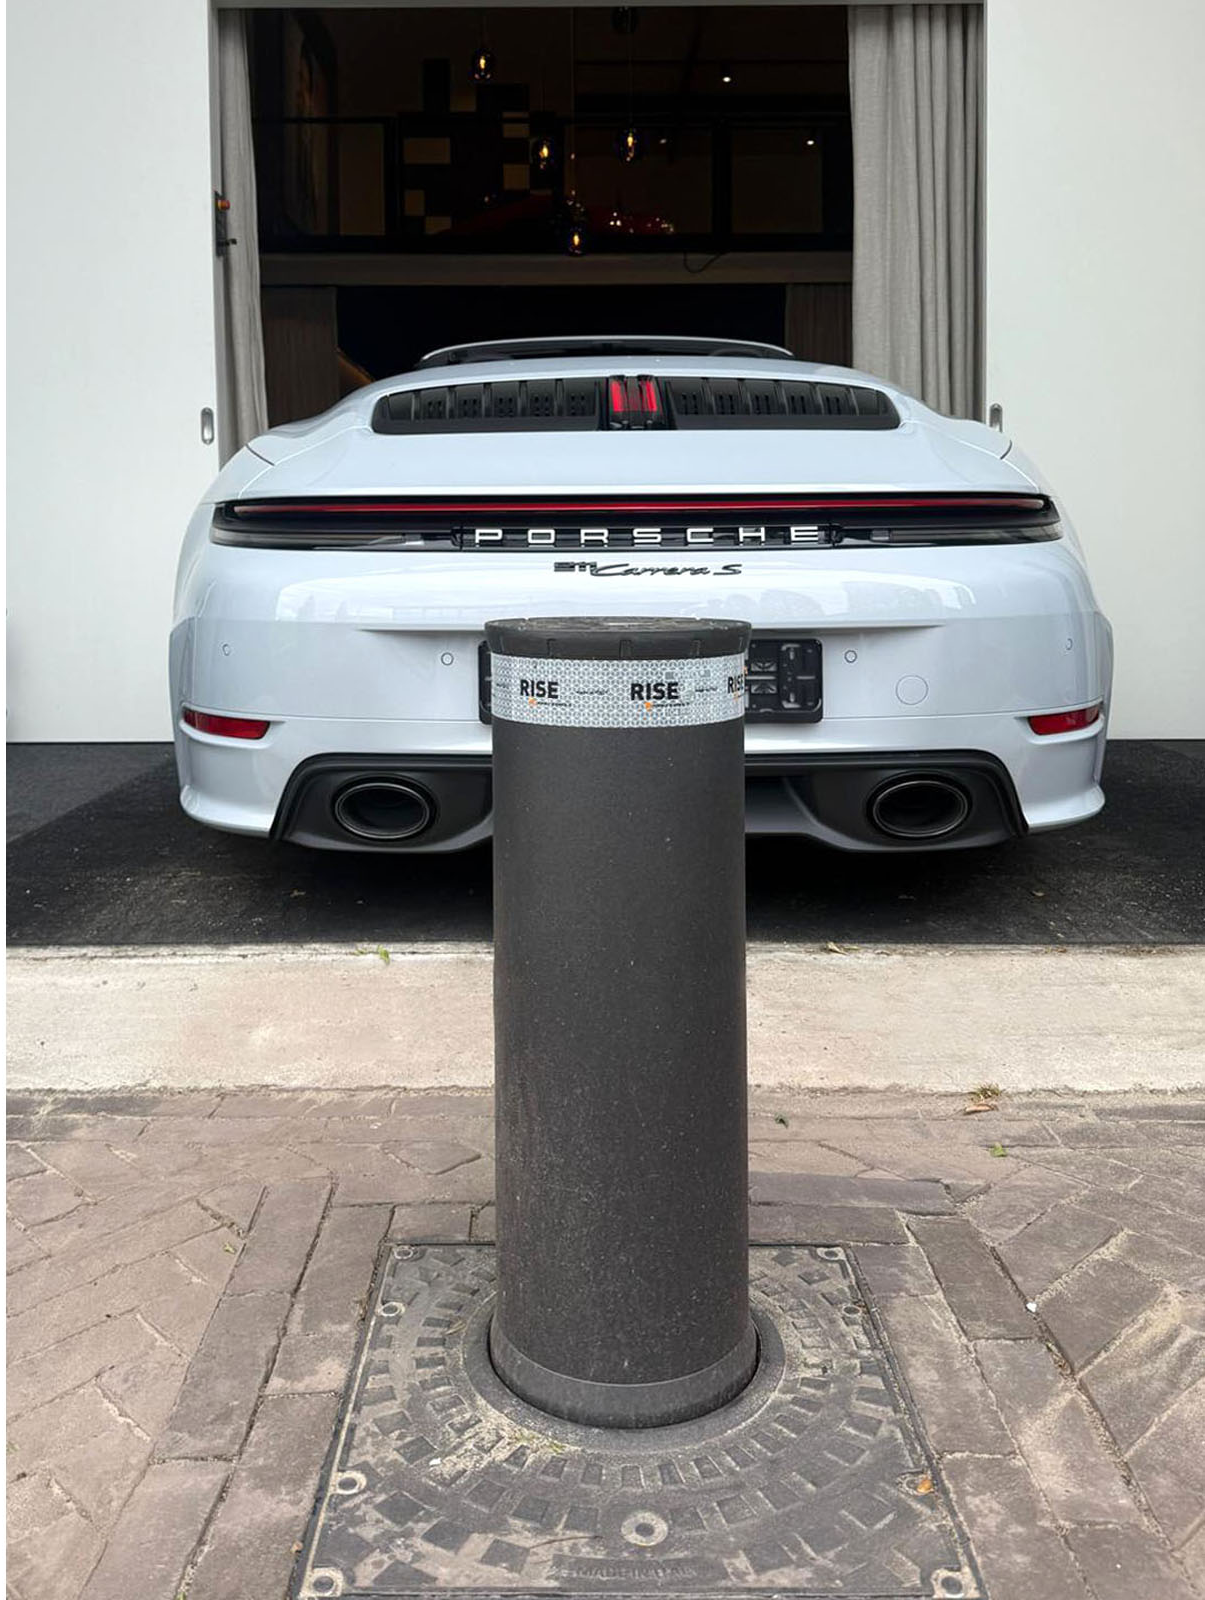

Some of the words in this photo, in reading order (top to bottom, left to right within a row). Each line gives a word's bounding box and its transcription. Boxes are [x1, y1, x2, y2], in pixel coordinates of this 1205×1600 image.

[475, 526, 819, 544] PORSCHE
[591, 563, 710, 576] Carrera
[713, 564, 743, 575] S
[520, 680, 558, 699] RISE
[631, 682, 678, 700] RISE
